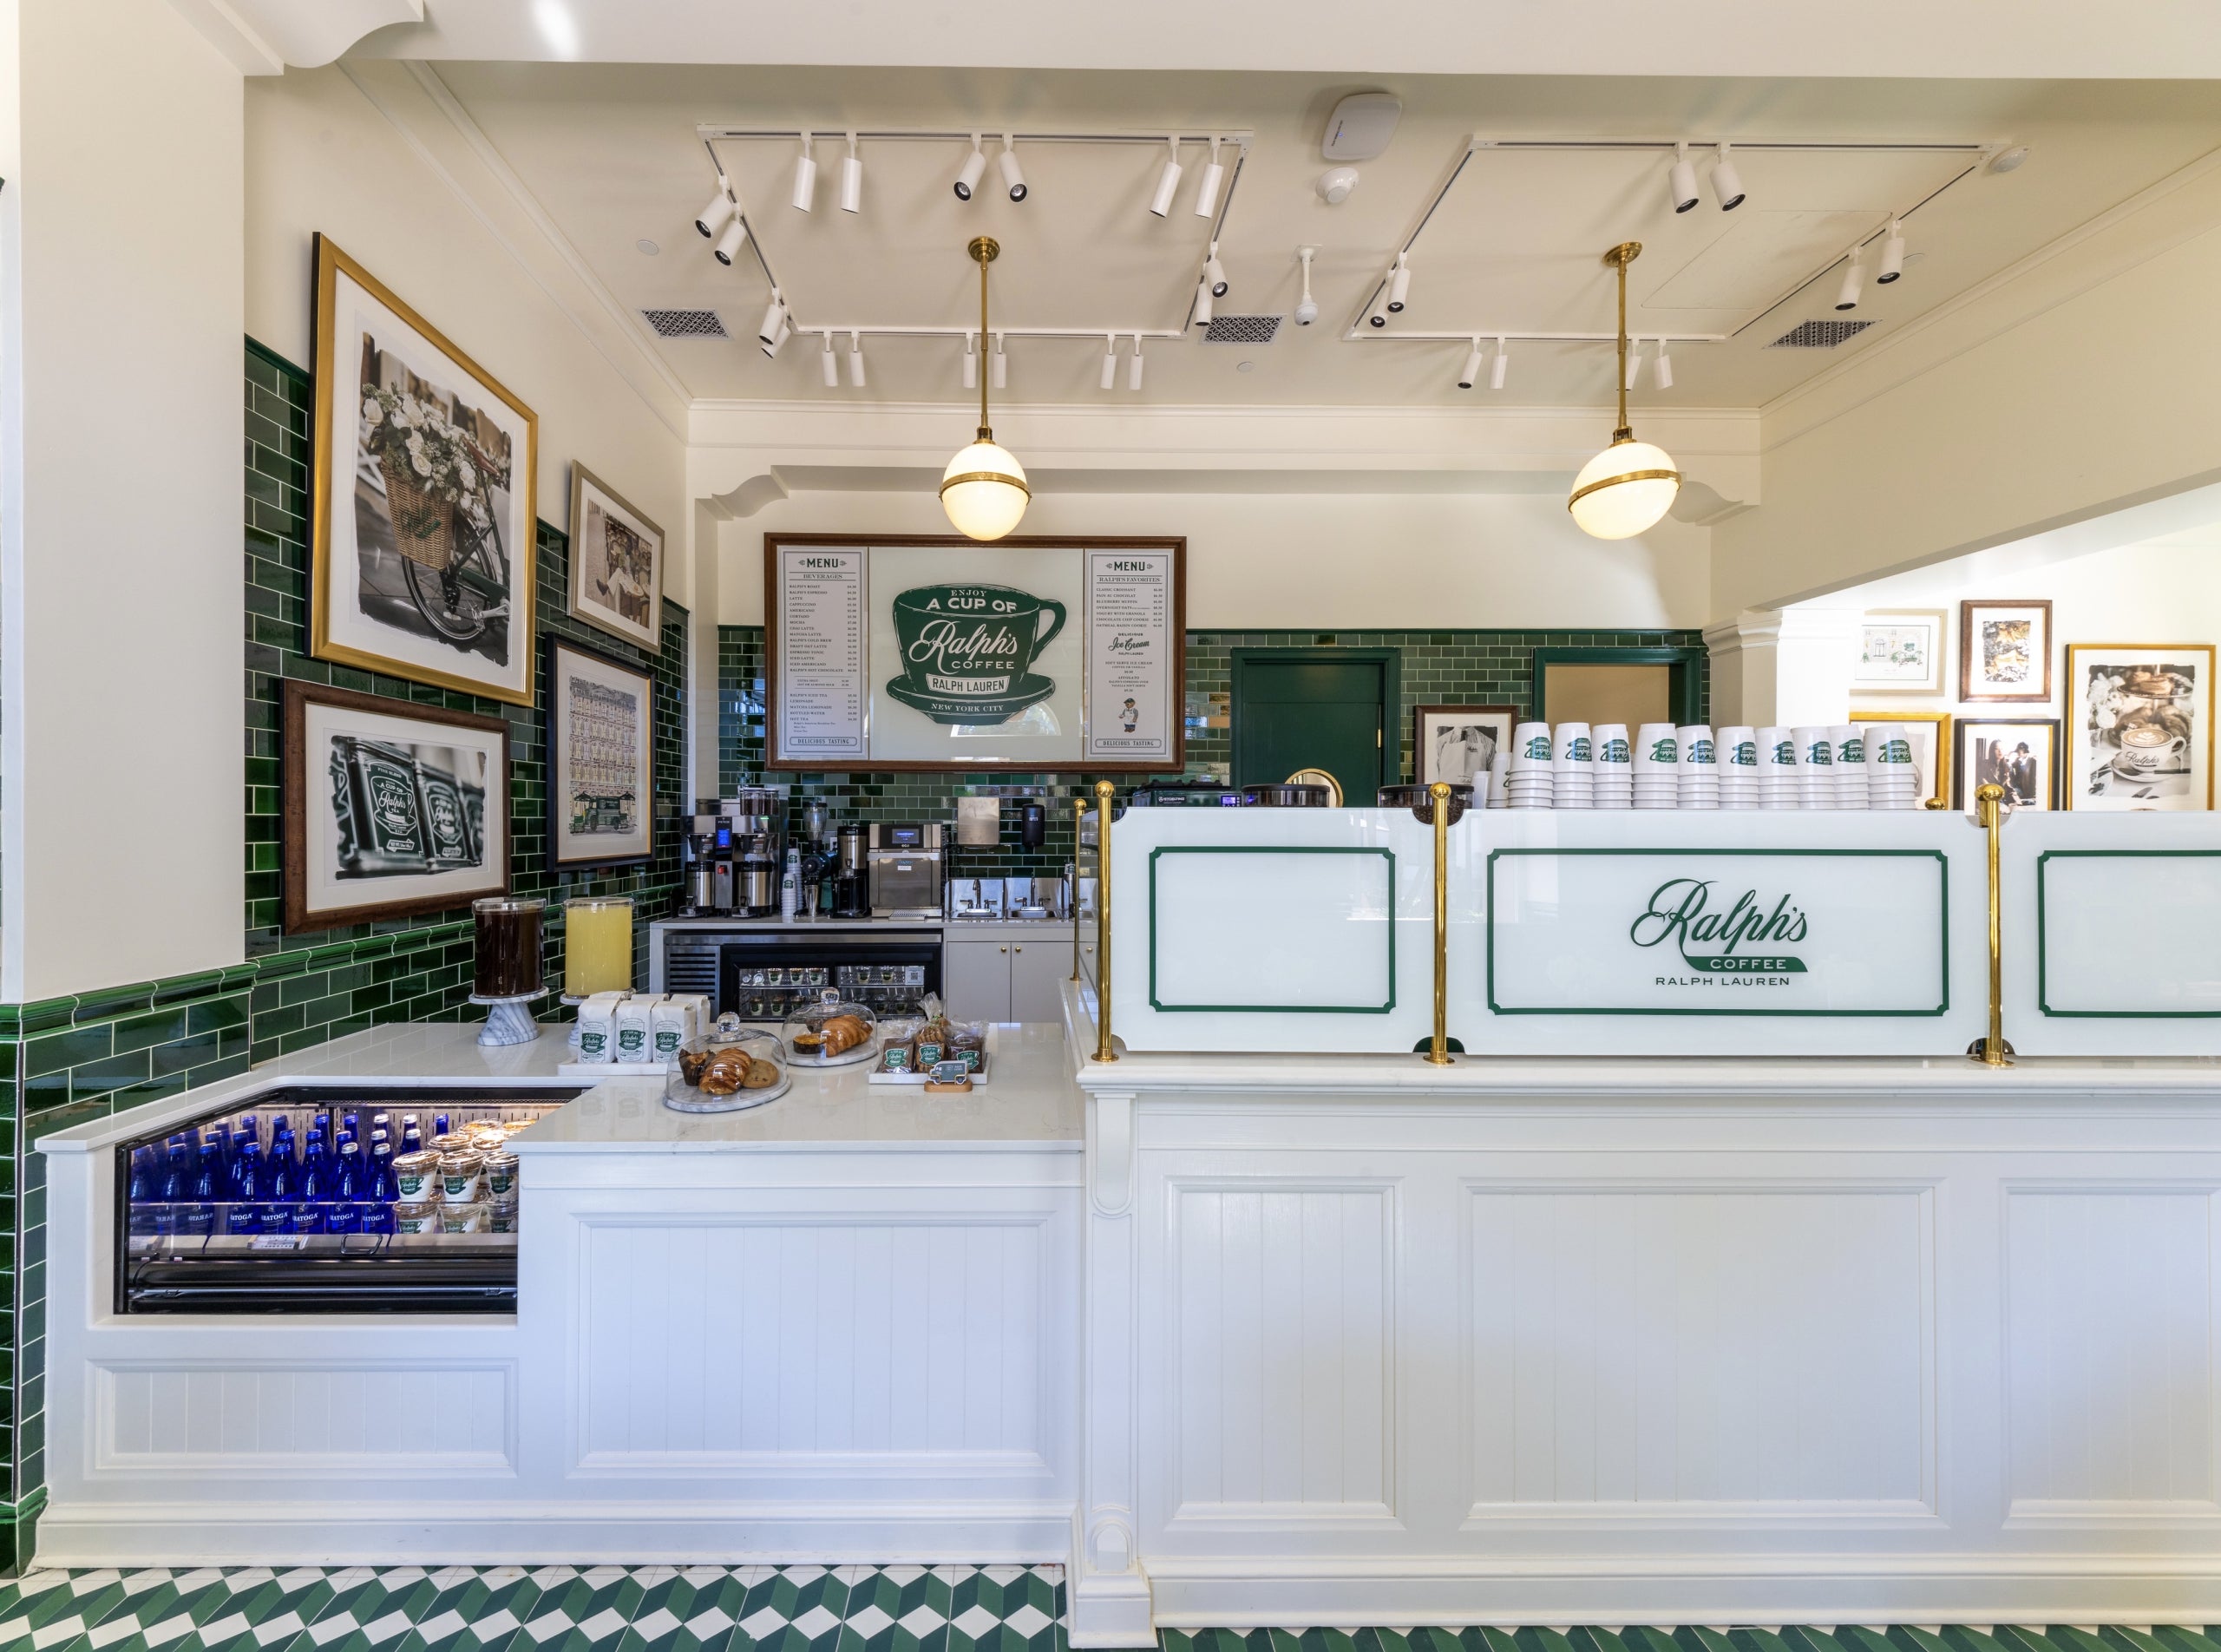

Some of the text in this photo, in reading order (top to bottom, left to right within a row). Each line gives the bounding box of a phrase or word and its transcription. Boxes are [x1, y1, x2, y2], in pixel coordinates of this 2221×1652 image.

[807, 558, 838, 567] MENU
[1114, 561, 1145, 571] MENU
[926, 598, 1018, 613] A CUP OF
[908, 620, 1018, 674] Ralph's
[1108, 637, 1150, 651] Ice Cream
[933, 678, 1005, 692] RALPH LAUREN
[2125, 751, 2159, 764] Ralph's
[378, 791, 406, 814] Ralph's
[1630, 878, 1808, 955] Ralph's
[1710, 959, 1786, 970] COFFEE
[1655, 977, 1791, 987] RALPH LAUREN
